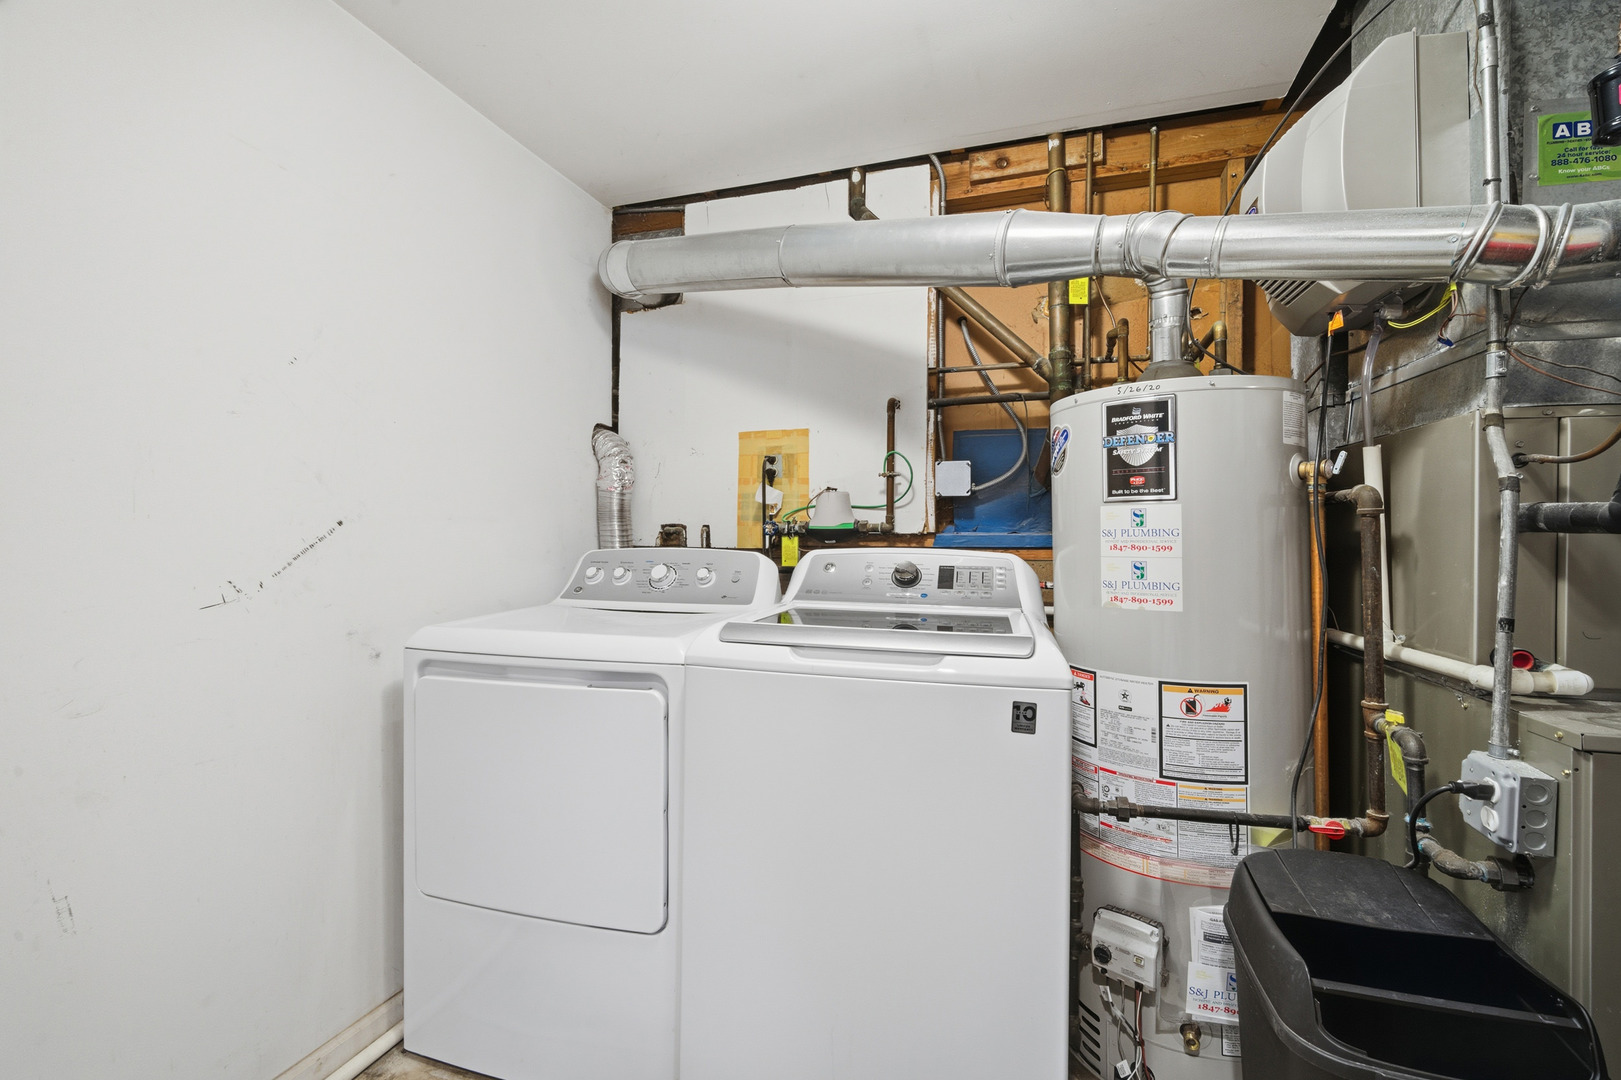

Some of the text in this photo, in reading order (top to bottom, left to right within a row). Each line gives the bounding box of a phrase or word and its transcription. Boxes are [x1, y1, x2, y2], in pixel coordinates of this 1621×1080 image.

[1554, 122, 1592, 138] AB
[1551, 154, 1618, 166] 888-476-1080
[1117, 384, 1161, 395] 5/26/20
[1111, 412, 1165, 423] BRADFORD WHITE
[1103, 432, 1176, 448] DEFENDER
[1101, 528, 1180, 539] S&J PLUMBING
[1109, 543, 1173, 552] 1847-890-1599
[1102, 580, 1180, 591] S&J PLUMBING
[1110, 596, 1174, 606] 1847-890-1599
[1188, 986, 1237, 1001] S&J PLU
[1198, 1003, 1239, 1015] 1847-89
